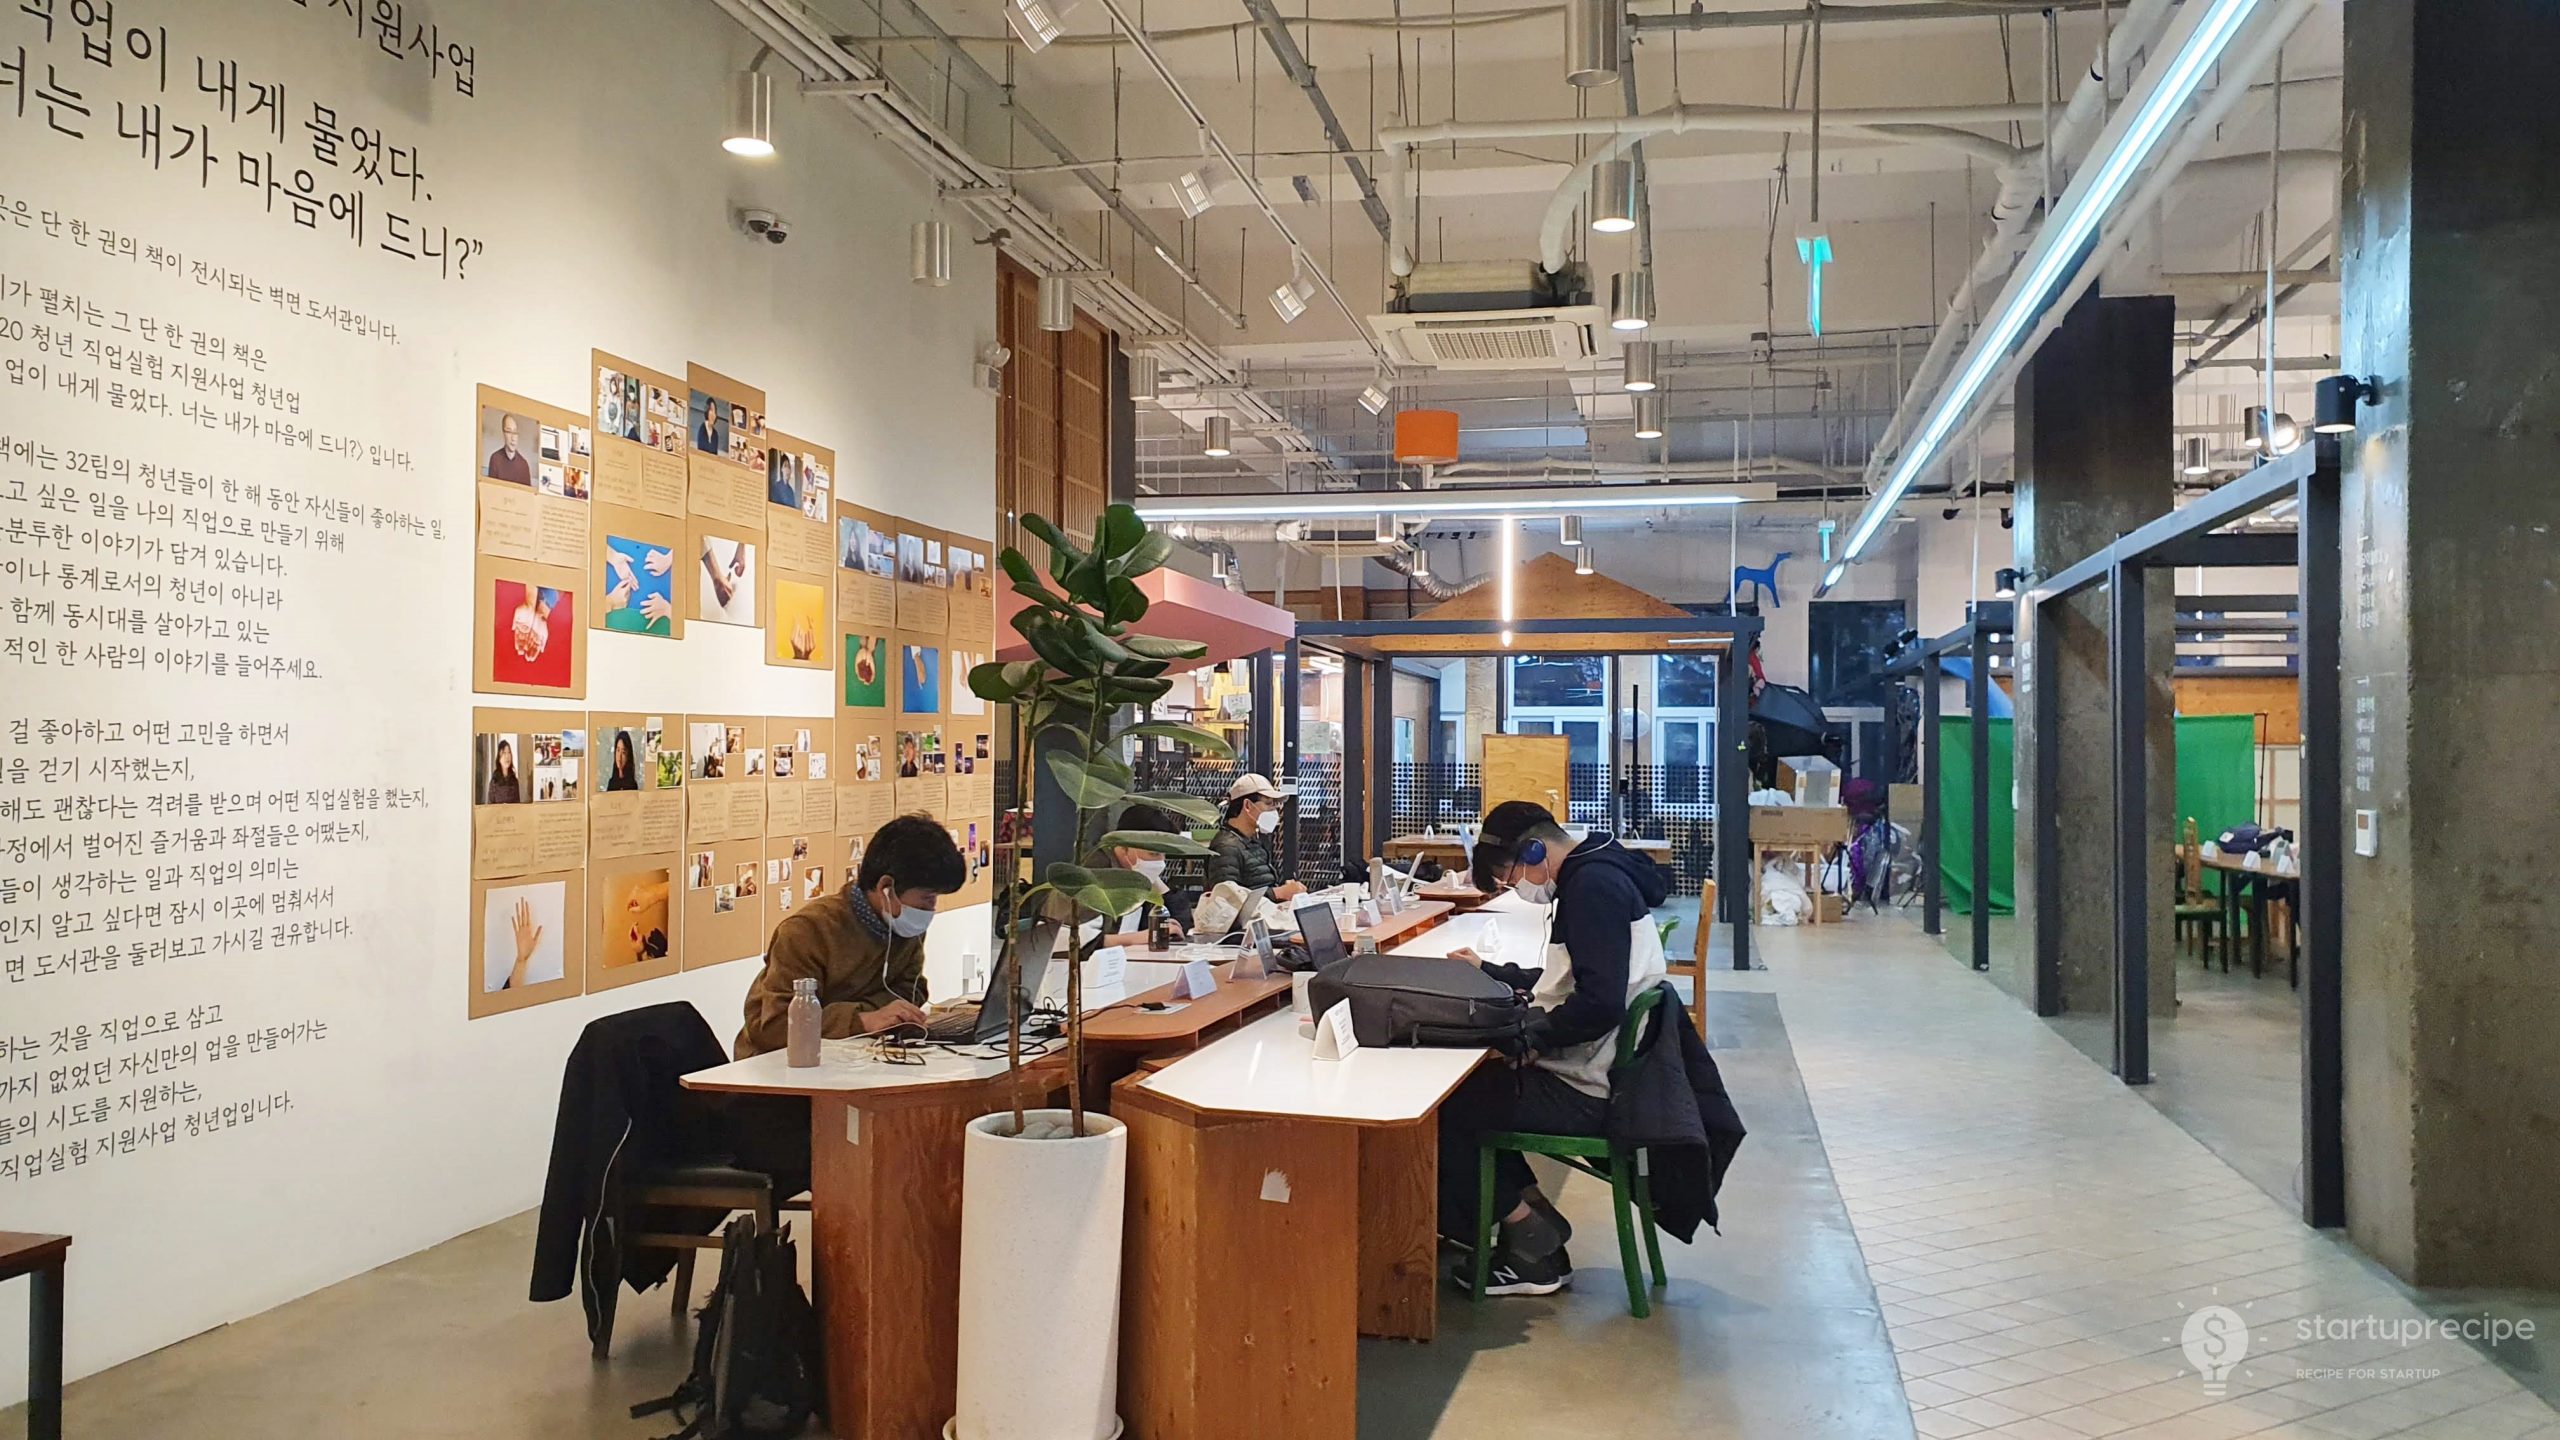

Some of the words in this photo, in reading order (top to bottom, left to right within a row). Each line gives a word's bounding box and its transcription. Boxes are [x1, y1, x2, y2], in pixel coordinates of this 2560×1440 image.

[196, 55, 285, 145] 내게
[303, 101, 433, 202] 물었다.
[116, 100, 219, 189] 내가
[237, 150, 364, 248] 마음에
[40, 210, 63, 239] 단
[68, 218, 91, 248] 한
[97, 229, 137, 263] 권의
[145, 244, 182, 278] 책이
[190, 260, 264, 303] 전시되는
[269, 285, 301, 316] 벽면
[305, 299, 400, 346] 도서관입니다.
[39, 287, 105, 328] 펼치는
[110, 310, 132, 333] 그
[138, 317, 159, 343] 단
[163, 323, 184, 350] 한
[189, 331, 225, 362] 권의
[232, 343, 268, 373] 책은
[30, 324, 73, 359] 청년
[82, 339, 163, 381] 직업실험
[170, 362, 244, 401] 지원사업
[251, 381, 300, 415] 청년업
[5, 358, 47, 391] 업이
[58, 371, 99, 403] 내게
[106, 381, 173, 418] 물었다.
[182, 400, 218, 429] 너는
[224, 410, 260, 438] 내가
[264, 419, 313, 451] 마음에
[369, 444, 414, 472] 입니다.
[36, 483, 81, 513] 싶은
[89, 491, 129, 521] 일을
[136, 499, 174, 529] 나의
[181, 507, 255, 538] 직업으로
[260, 520, 308, 549] 만들기
[314, 529, 344, 554] 위해
[65, 450, 130, 485] 32팀의
[138, 463, 213, 499] 청년들이
[221, 479, 240, 504] 한
[244, 484, 261, 508] 해
[266, 488, 300, 514] 동안
[304, 495, 364, 526] 자신들이
[370, 507, 426, 537] 좋아하는
[430, 519, 446, 540] 일,
[0, 517, 74, 551] 분투한
[81, 528, 164, 563] 이야기가
[170, 541, 206, 569] 담겨
[214, 547, 288, 579] 있습니다.
[0, 557, 51, 587] 이나
[56, 563, 161, 600] 통계로서의
[169, 577, 223, 606] 청년이
[231, 584, 284, 611] 아니라
[9, 596, 55, 627] 함께
[62, 603, 148, 635] 동시대를
[154, 611, 231, 640] 살아가고
[237, 619, 270, 645] 있는
[3, 636, 48, 665] 적인
[55, 640, 78, 667] 한
[83, 642, 146, 671] 사람의
[154, 647, 230, 677] 이야기를
[234, 654, 323, 681] 들어주세요.
[8, 717, 29, 745] 걸
[37, 717, 125, 745] 좋아하고
[132, 719, 170, 745] 어떤
[176, 721, 234, 746] 고민을
[238, 722, 289, 746] 하면서
[38, 756, 79, 783] 걷기
[88, 756, 195, 783] 시작했는지,
[0, 796, 46, 824] 해도
[52, 793, 139, 822] 괜찮다는
[146, 792, 204, 818] 격려를
[209, 790, 261, 816] 받으며
[267, 789, 299, 813] 어떤
[305, 787, 381, 811] 직업실험을
[384, 787, 429, 809] 했는지,
[0, 833, 73, 864] 정에서
[83, 830, 143, 859] 벌어진
[150, 826, 227, 855] 즐거움과
[231, 823, 300, 849] 좌절들은
[305, 819, 369, 844] 어땠는지,
[0, 874, 42, 905] 들이
[51, 868, 138, 900] 생각하는
[145, 864, 184, 892] 일과
[189, 859, 243, 887] 직업의
[248, 857, 300, 882] 의미는
[0, 913, 42, 945] 인지
[51, 910, 95, 939] 알고
[102, 901, 162, 933] 싶다면
[168, 897, 205, 925] 잠시
[213, 892, 265, 919] 이곳에
[271, 885, 334, 914] 멈춰서서
[5, 954, 25, 984] 면
[32, 944, 122, 978] 도서관을
[127, 936, 207, 967] 둘러보고
[212, 926, 264, 955] 가시길
[270, 916, 353, 948] 권유합니다.
[49, 1024, 93, 1056] 것을
[99, 1011, 181, 1045] 직업으로
[185, 1004, 224, 1030] 삼고
[49, 1056, 112, 1095] 없었던
[118, 1040, 197, 1078] 자신만의
[205, 1034, 241, 1063] 업을
[246, 1019, 328, 1054] 만들어가는
[0, 1137, 88, 1182] 직업실험
[95, 1116, 176, 1158] 지원사업
[183, 1090, 294, 1137] 청년업입니다.
[46, 1096, 112, 1132] 시도를
[118, 1080, 202, 1115] 지원하는,
